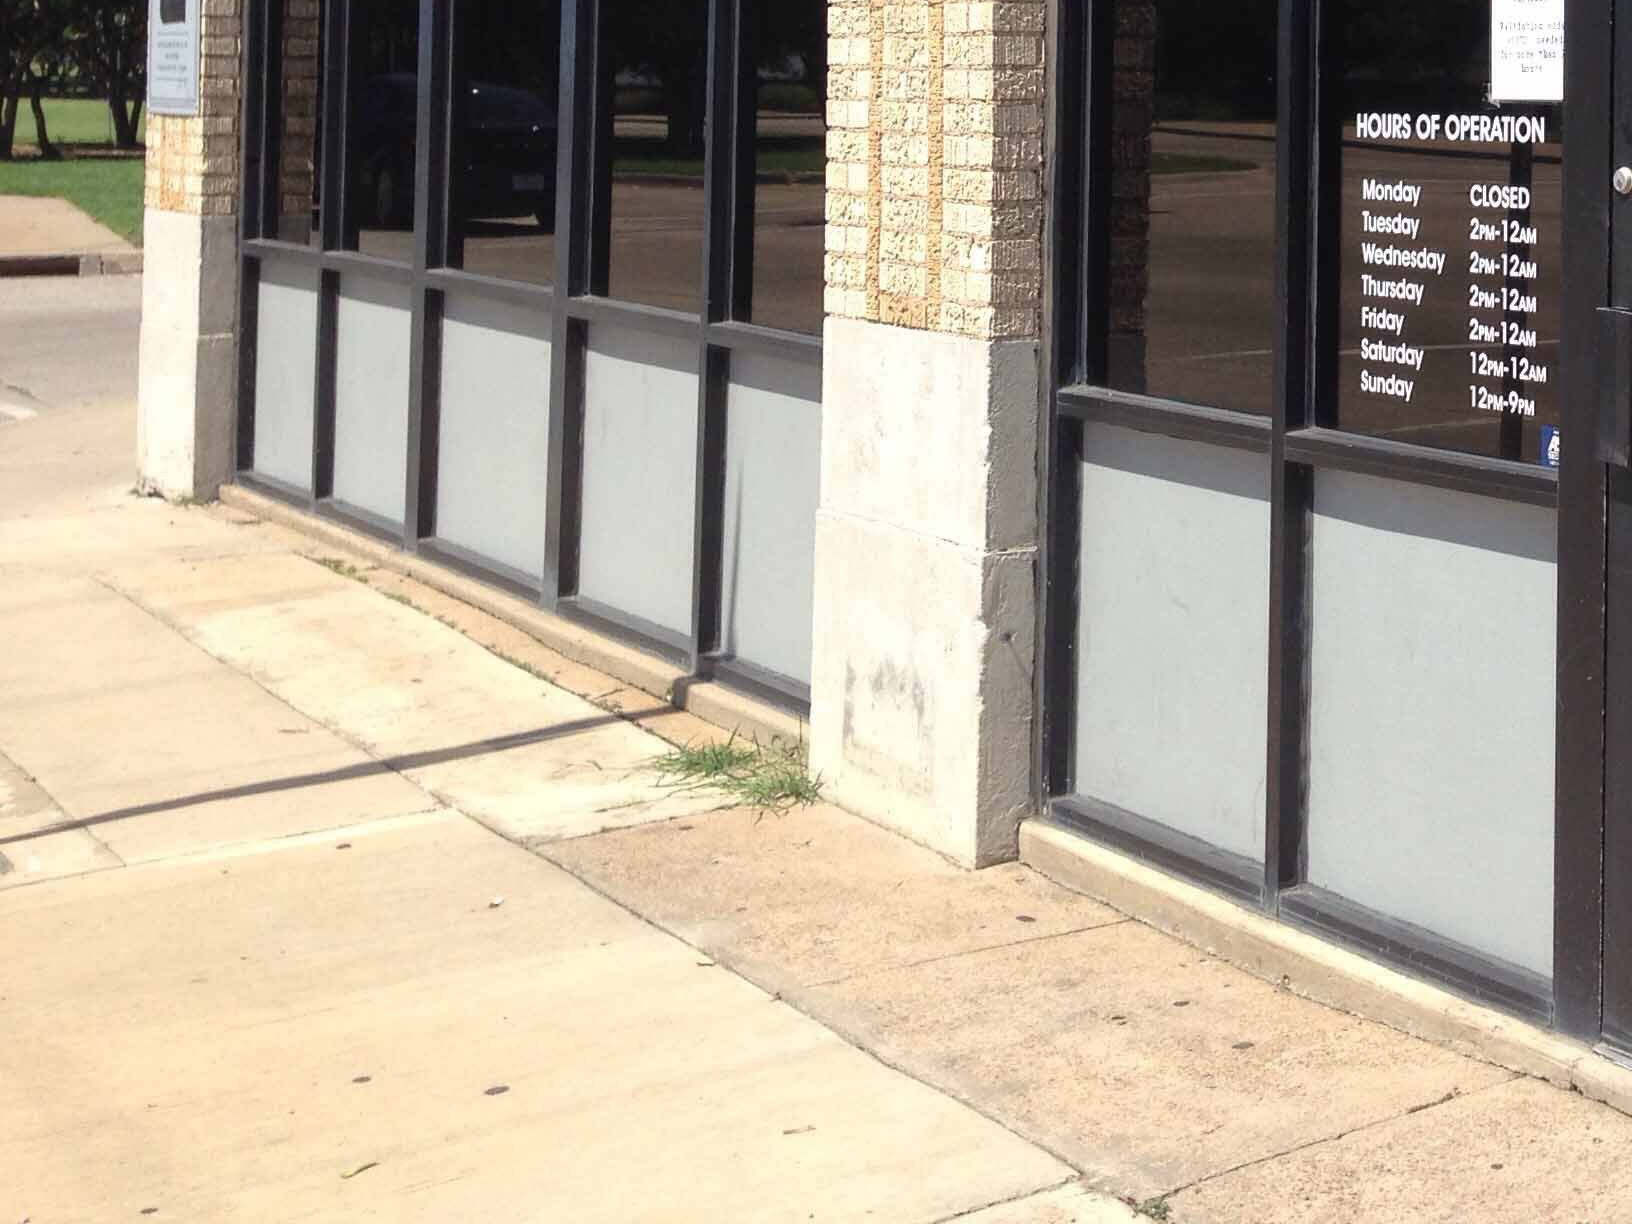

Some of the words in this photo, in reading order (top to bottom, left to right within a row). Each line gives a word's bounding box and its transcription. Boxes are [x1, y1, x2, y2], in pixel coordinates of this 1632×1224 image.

[1356, 113, 1411, 139] HOURS
[1416, 114, 1440, 140] OF
[1445, 114, 1545, 143] OPERATION
[1362, 178, 1421, 206] Monday
[1470, 184, 1530, 209] CLOSED
[1361, 210, 1420, 240] Tuesday
[1470, 217, 1537, 245] 2PM-12AM
[1361, 242, 1446, 275] Wednesday
[1469, 251, 1537, 279] 2PM-12AM
[1361, 274, 1424, 305] Thursday
[1469, 284, 1537, 313] 2PM-12AM
[1361, 306, 1405, 336] Friday
[1469, 318, 1537, 348] 2PM-12AM
[1360, 337, 1424, 371] Saturday
[1470, 351, 1547, 383] 12PM-12AM
[1360, 369, 1414, 402] Sunday
[1469, 385, 1536, 416] 12PM-9PM
